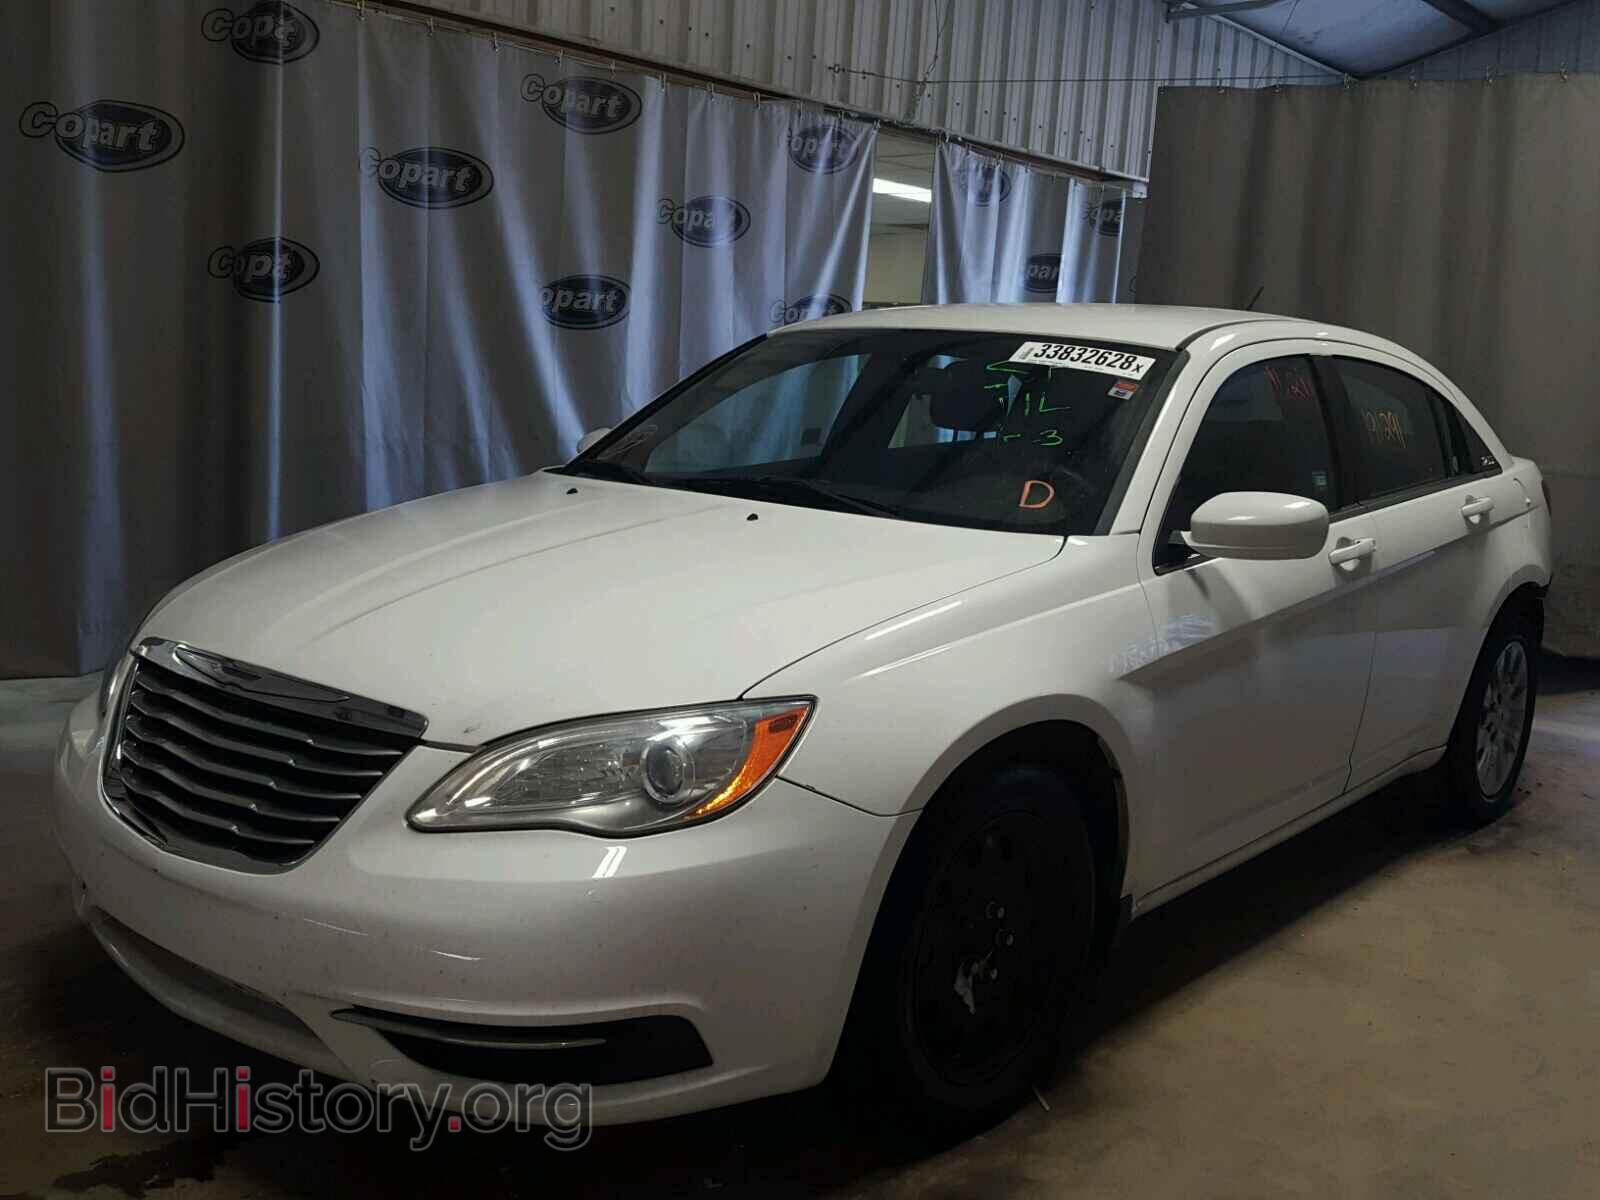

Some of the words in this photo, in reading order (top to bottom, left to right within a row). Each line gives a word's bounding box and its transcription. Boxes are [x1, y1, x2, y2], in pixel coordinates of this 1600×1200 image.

[520, 73, 622, 118] Copart
[18, 101, 161, 151] Copart
[359, 146, 473, 192] Copart
[540, 287, 618, 313] opart
[1018, 479, 1055, 510] D
